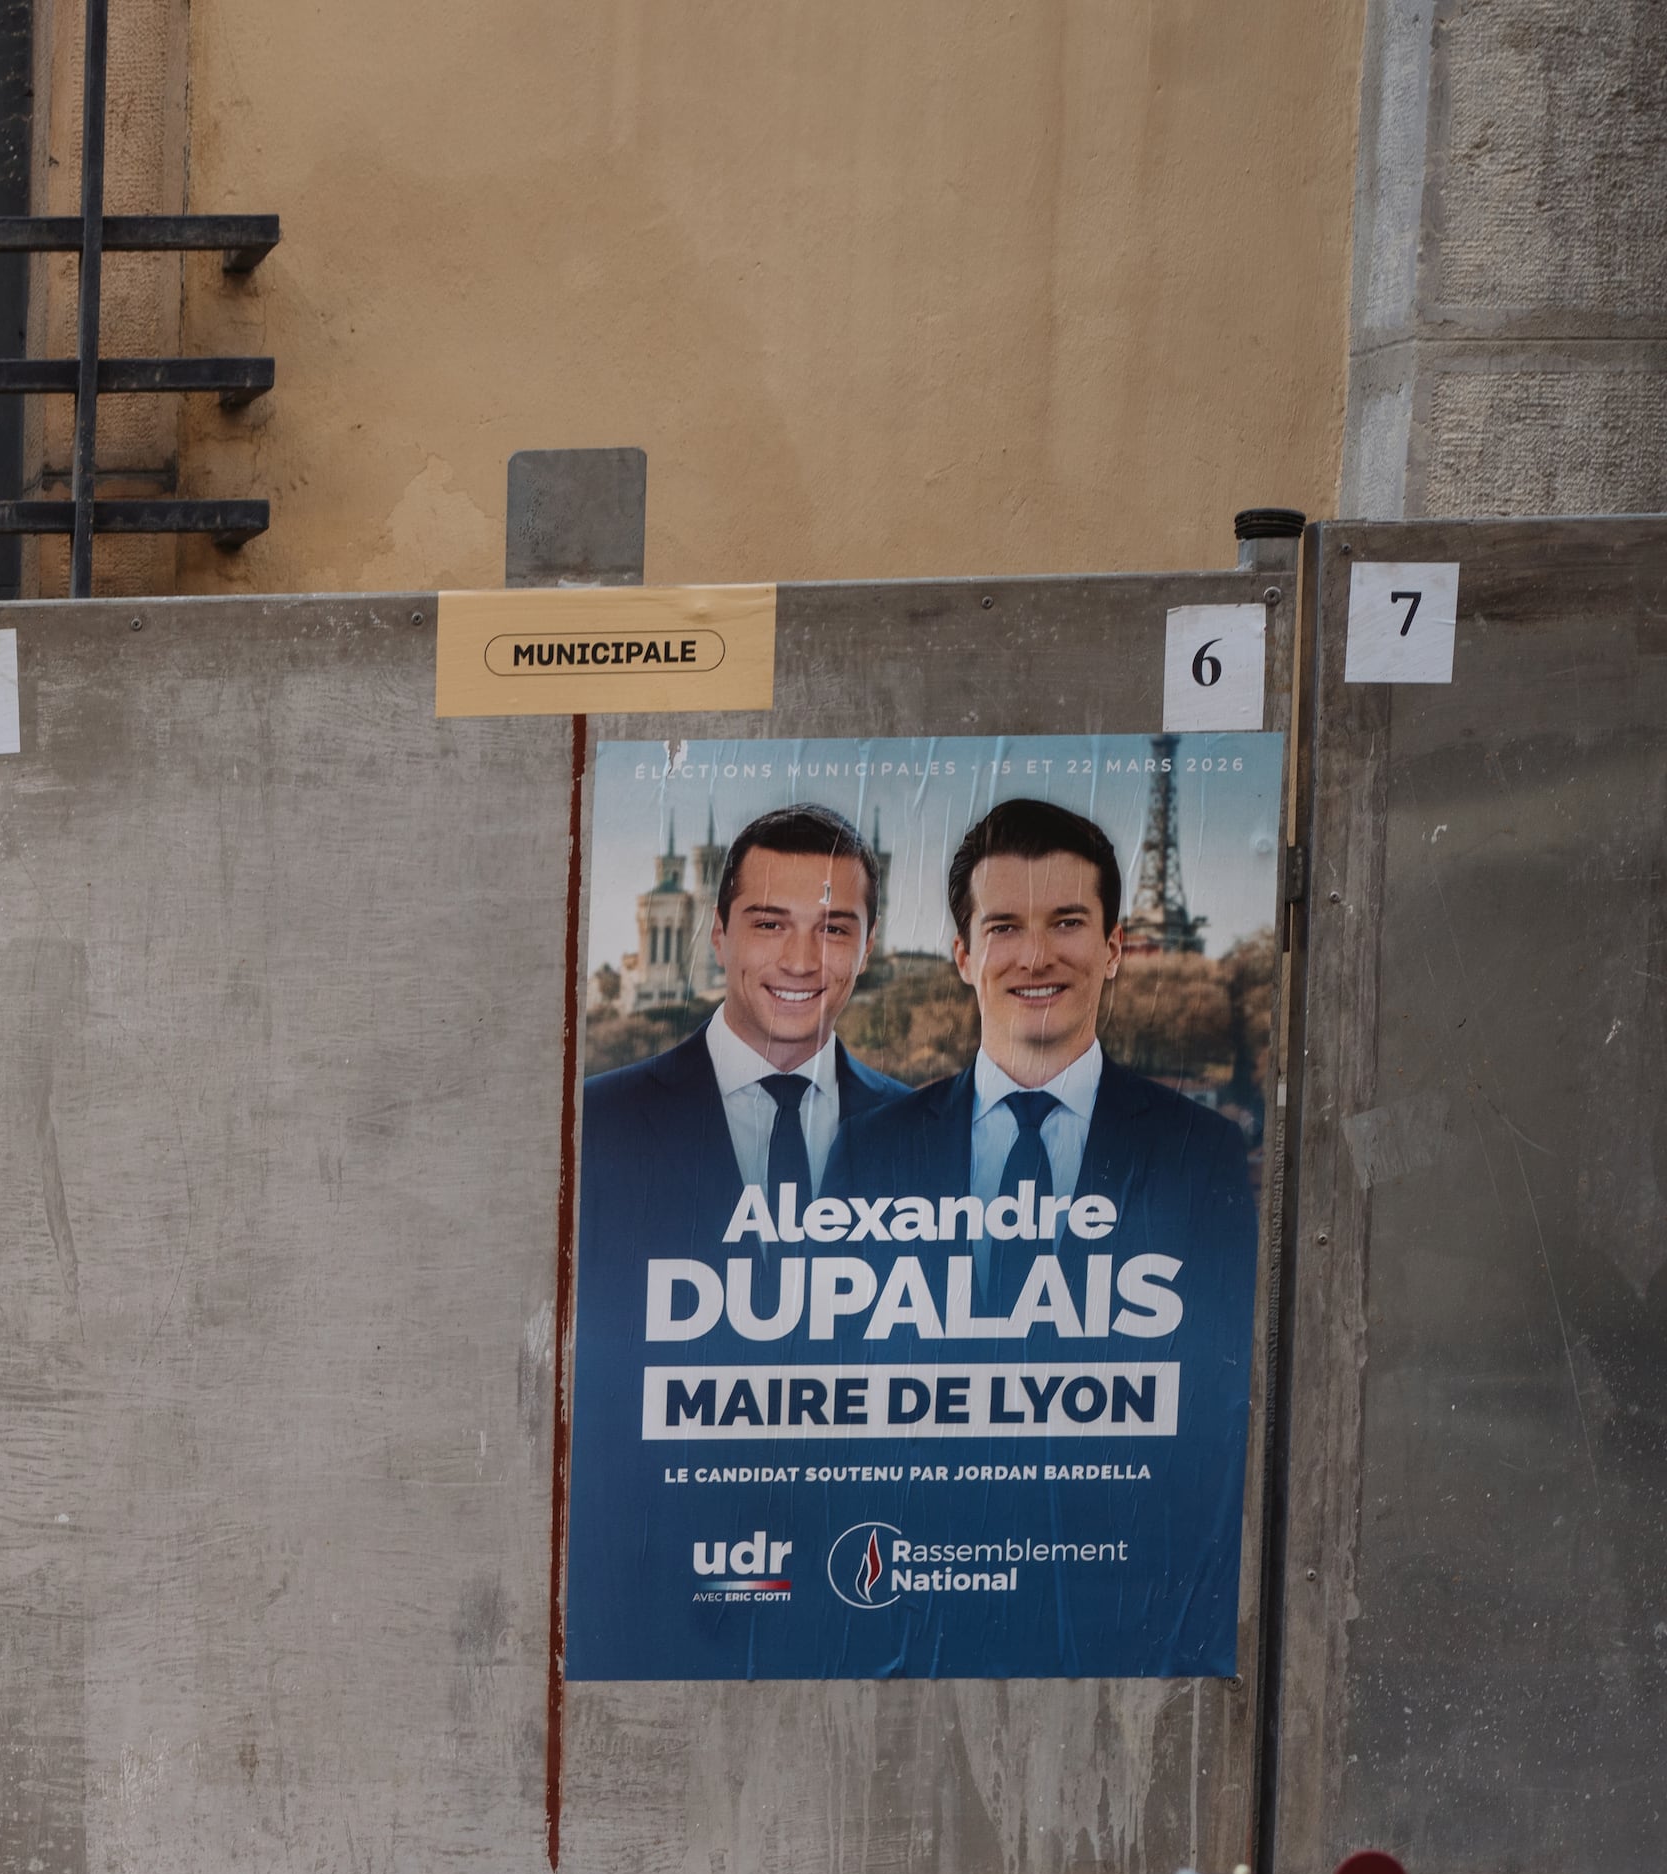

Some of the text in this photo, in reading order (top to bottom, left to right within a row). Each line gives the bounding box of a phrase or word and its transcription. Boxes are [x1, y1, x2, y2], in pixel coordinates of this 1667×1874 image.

[1390, 591, 1422, 637] 7
[513, 640, 697, 667] MUNICIPALE
[1191, 638, 1222, 687] 6
[788, 761, 955, 777] MUNICIPALES
[990, 760, 1012, 775] 15
[1027, 760, 1054, 774] ET
[1067, 760, 1093, 774] 22
[1106, 758, 1173, 773] MARS
[1186, 757, 1244, 772] 2026
[721, 1180, 1118, 1243] Alexandre
[645, 1253, 1184, 1342] DUPALAIS
[665, 1375, 1157, 1427] MAIRE DE LYON
[664, 1464, 1151, 1483] LE CANDIDAT SOUTENU PAR JORDAN BARDELLA
[693, 1530, 793, 1576] udr
[892, 1538, 1128, 1563] Rassemblement
[692, 1591, 791, 1602] AVEC ERIC CIOTTI
[891, 1566, 1018, 1592] National
